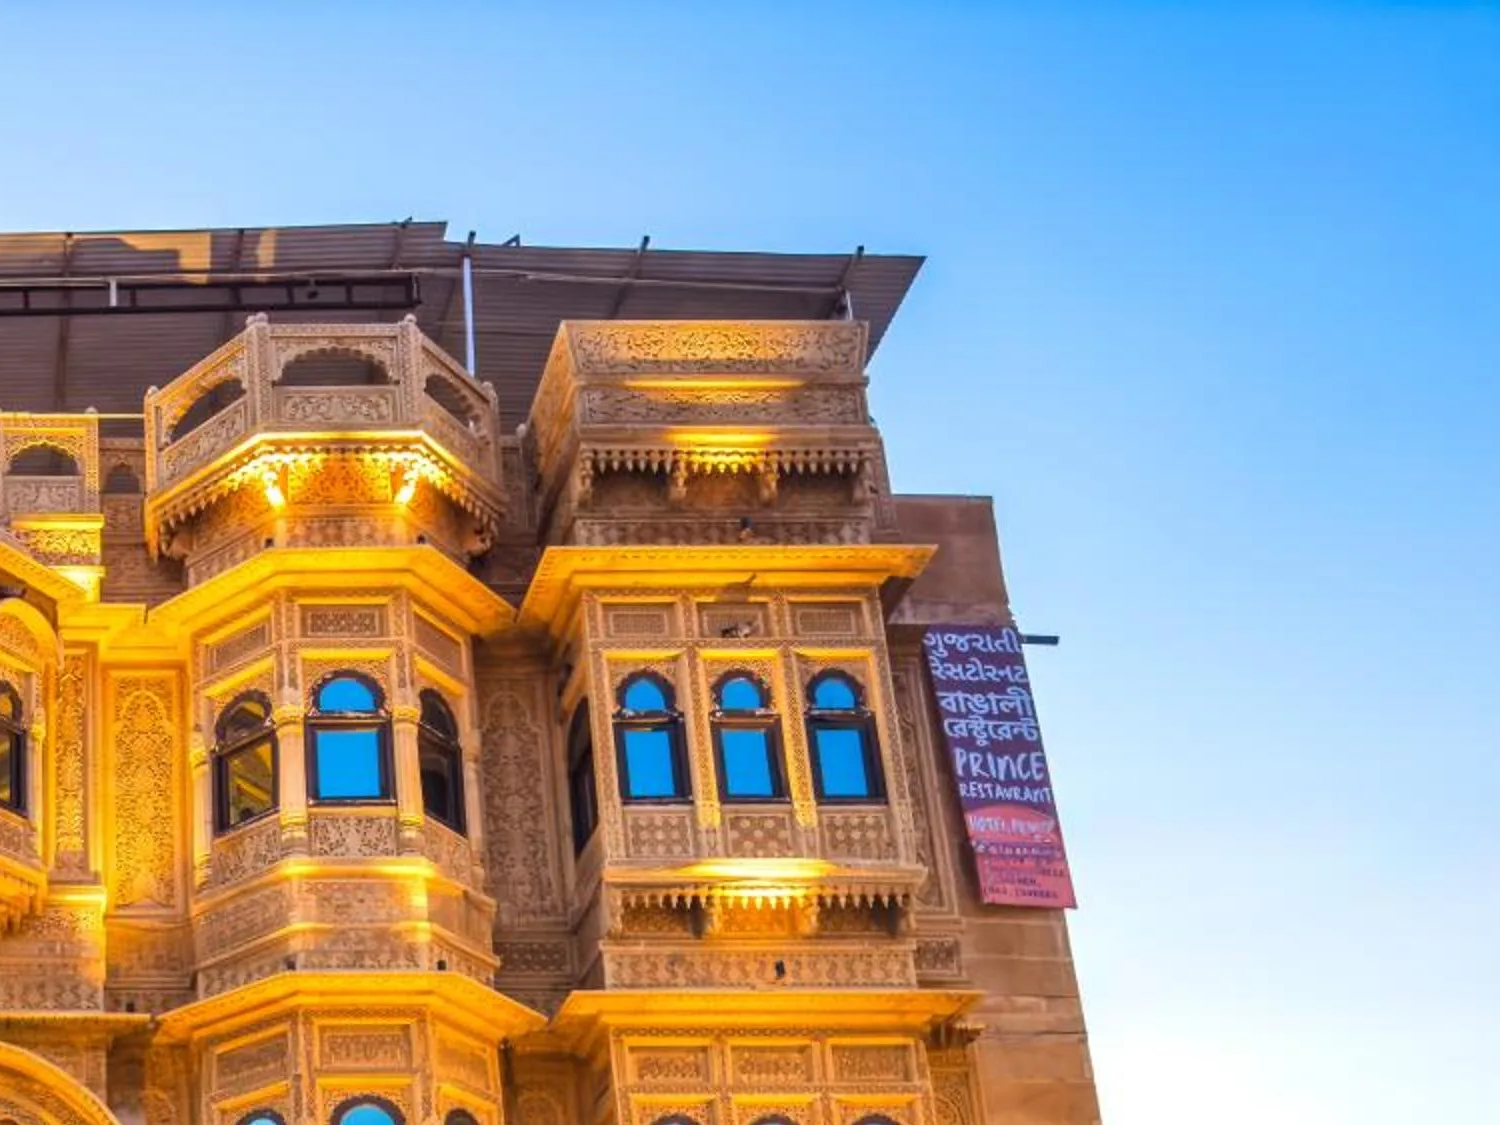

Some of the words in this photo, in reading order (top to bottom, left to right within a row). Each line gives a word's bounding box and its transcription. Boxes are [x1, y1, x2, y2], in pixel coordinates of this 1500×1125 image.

[923, 628, 1021, 657] ગુજરાતી
[954, 748, 1045, 781] PRINCE
[959, 782, 1051, 804] RESTAURANT
